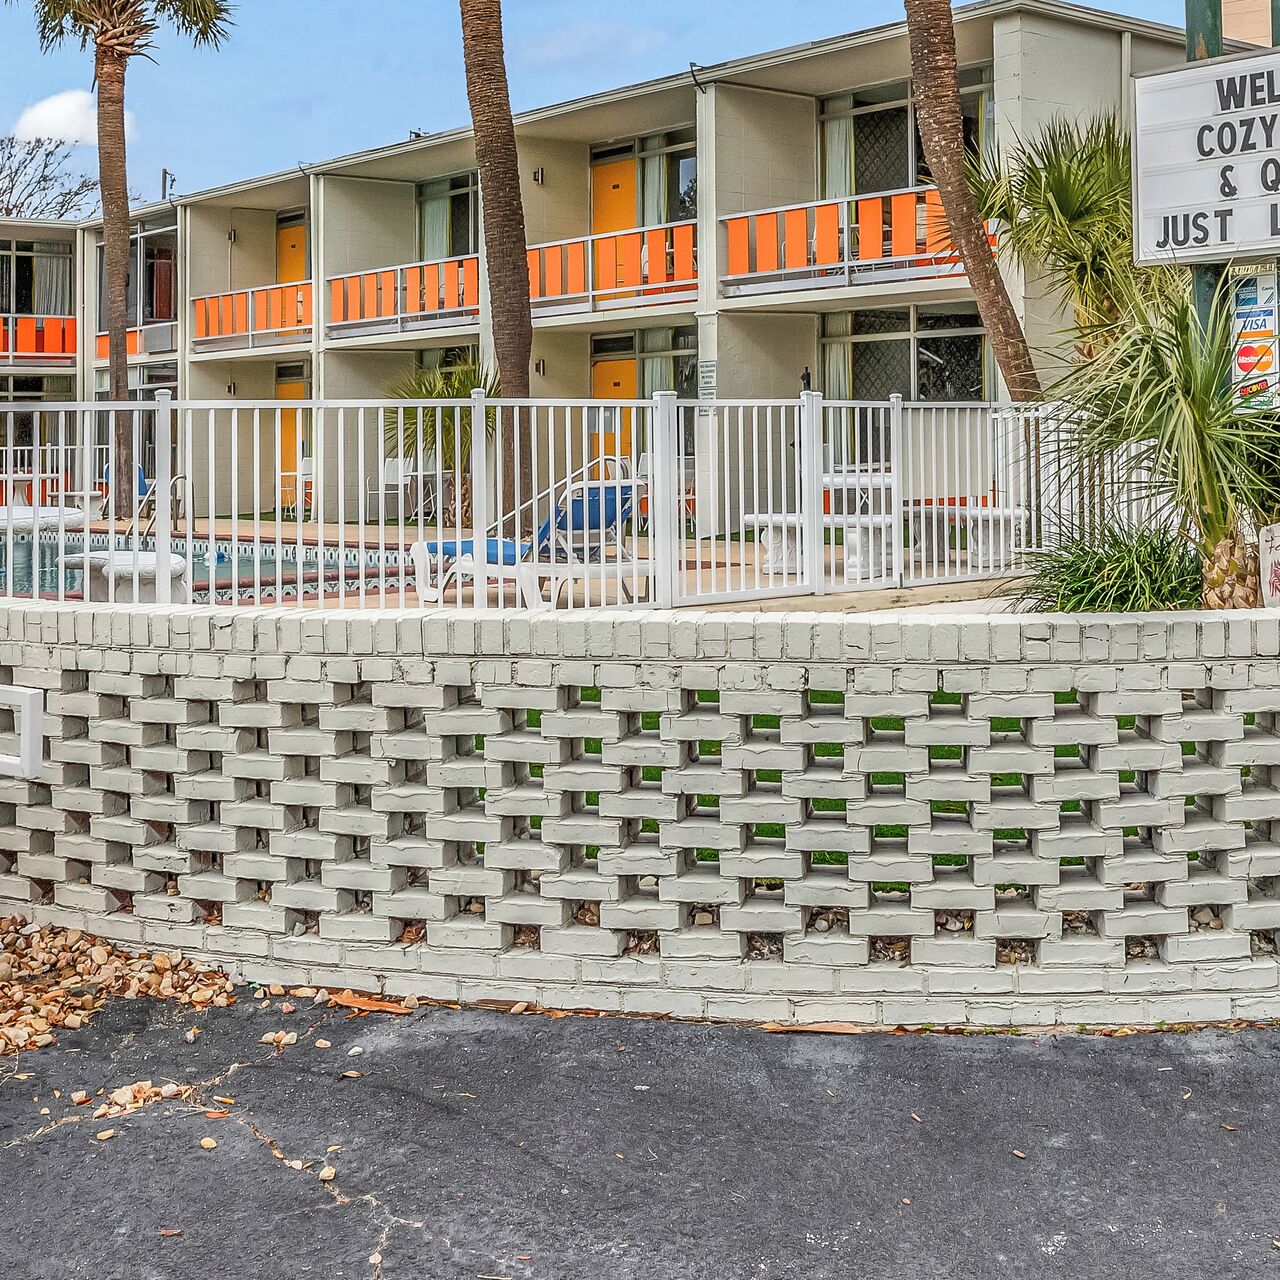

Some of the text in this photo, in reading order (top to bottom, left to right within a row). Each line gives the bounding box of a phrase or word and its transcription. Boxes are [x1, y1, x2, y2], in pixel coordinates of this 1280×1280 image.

[1196, 113, 1279, 158] COZY
[1219, 164, 1238, 198] &
[1155, 208, 1234, 249] JUST
[1241, 318, 1267, 331] VISA
